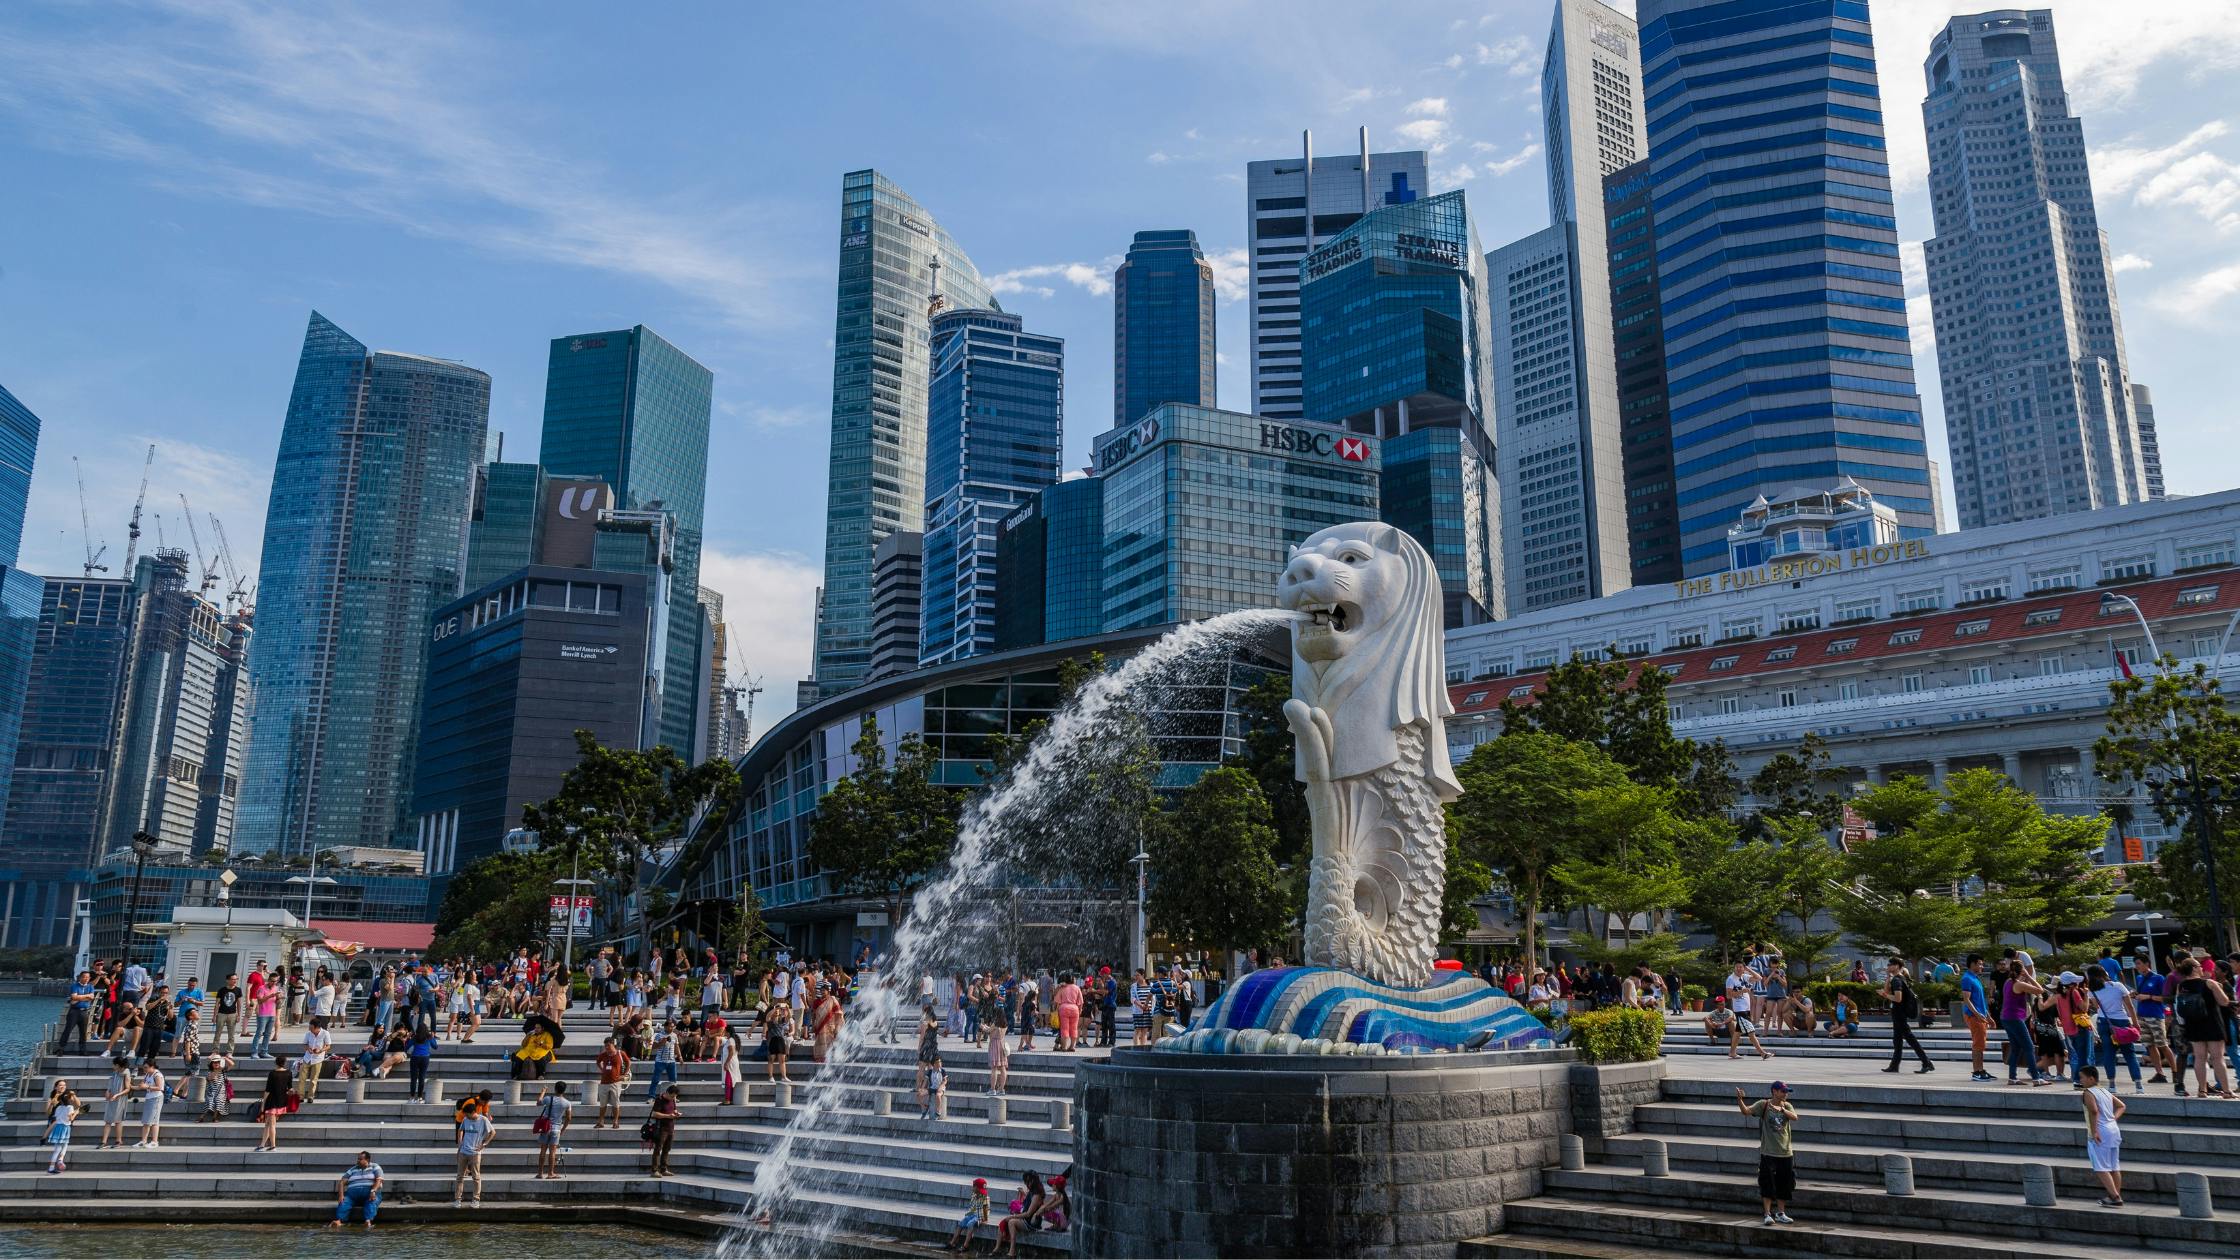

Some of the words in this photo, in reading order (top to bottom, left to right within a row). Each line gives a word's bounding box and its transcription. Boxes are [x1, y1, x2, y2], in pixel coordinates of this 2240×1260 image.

[903, 216, 929, 233] Keppel
[843, 234, 868, 248] ANZ
[1307, 235, 1360, 266] STRAITS
[1398, 233, 1459, 253] STRAITS
[1308, 249, 1362, 278] TRADING
[1395, 245, 1460, 267] TRADING
[1101, 428, 1139, 471] HSBC
[1260, 424, 1331, 456] HSBC
[1674, 579, 1712, 597] THE
[1719, 554, 1842, 590] FULLERTON
[1851, 539, 1929, 567] HOTEL
[433, 617, 458, 642] OUE
